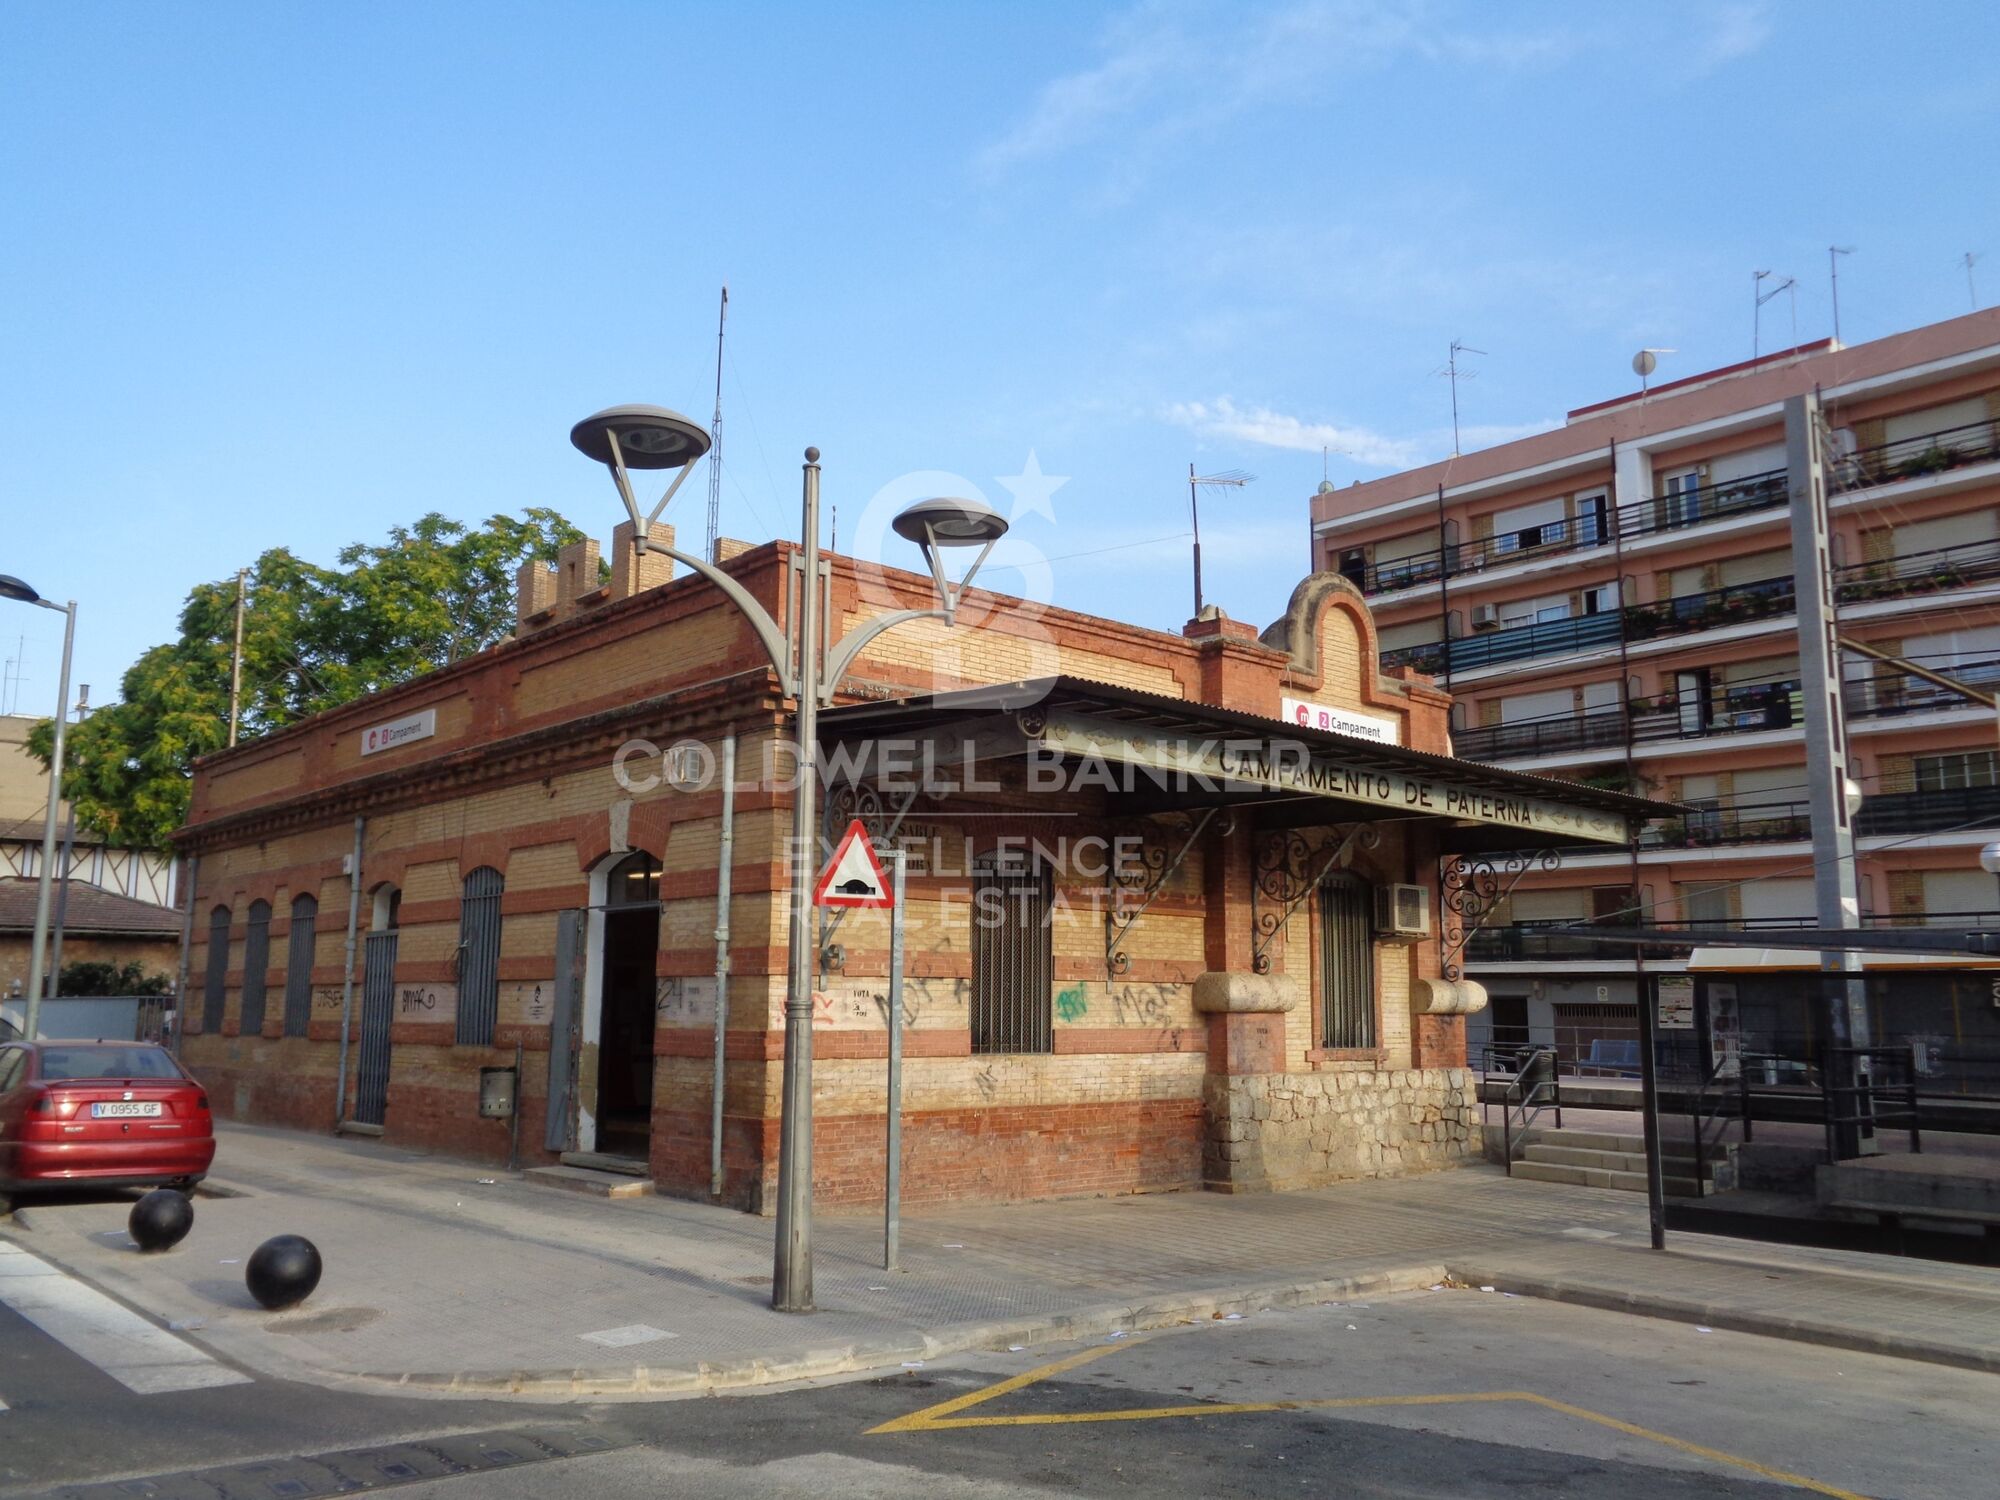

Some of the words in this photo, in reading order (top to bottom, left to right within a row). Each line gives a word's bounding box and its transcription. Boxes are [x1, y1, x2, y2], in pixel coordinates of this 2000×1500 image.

[1331, 717, 1381, 738] Campament
[1219, 752, 1390, 799] CAMPAMENTO
[1404, 782, 1433, 807] DE
[1446, 789, 1532, 823] PATERNA
[99, 1104, 106, 1115] V
[111, 1104, 140, 1115] 0955
[144, 1103, 158, 1114] GF
